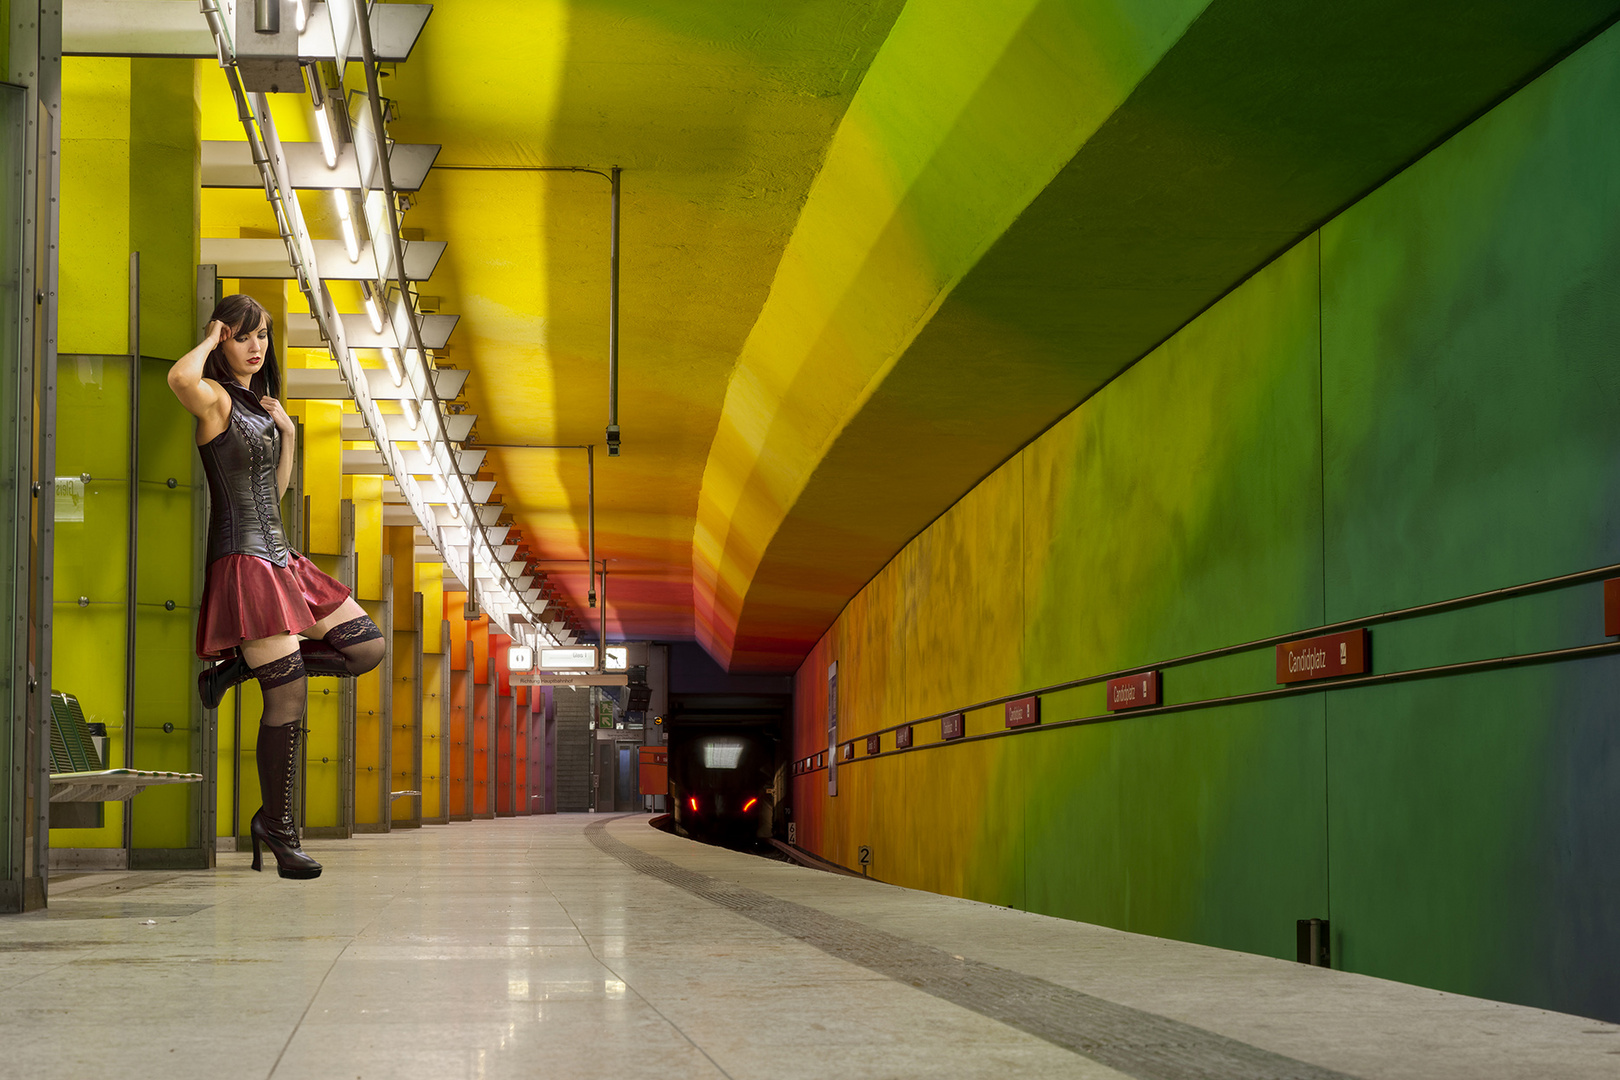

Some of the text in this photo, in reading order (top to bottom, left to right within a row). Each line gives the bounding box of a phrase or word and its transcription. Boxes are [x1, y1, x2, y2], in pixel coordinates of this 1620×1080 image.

[1288, 646, 1326, 677] Candidplatz
[1113, 683, 1136, 706] Candidplatz
[860, 848, 870, 863] 2
